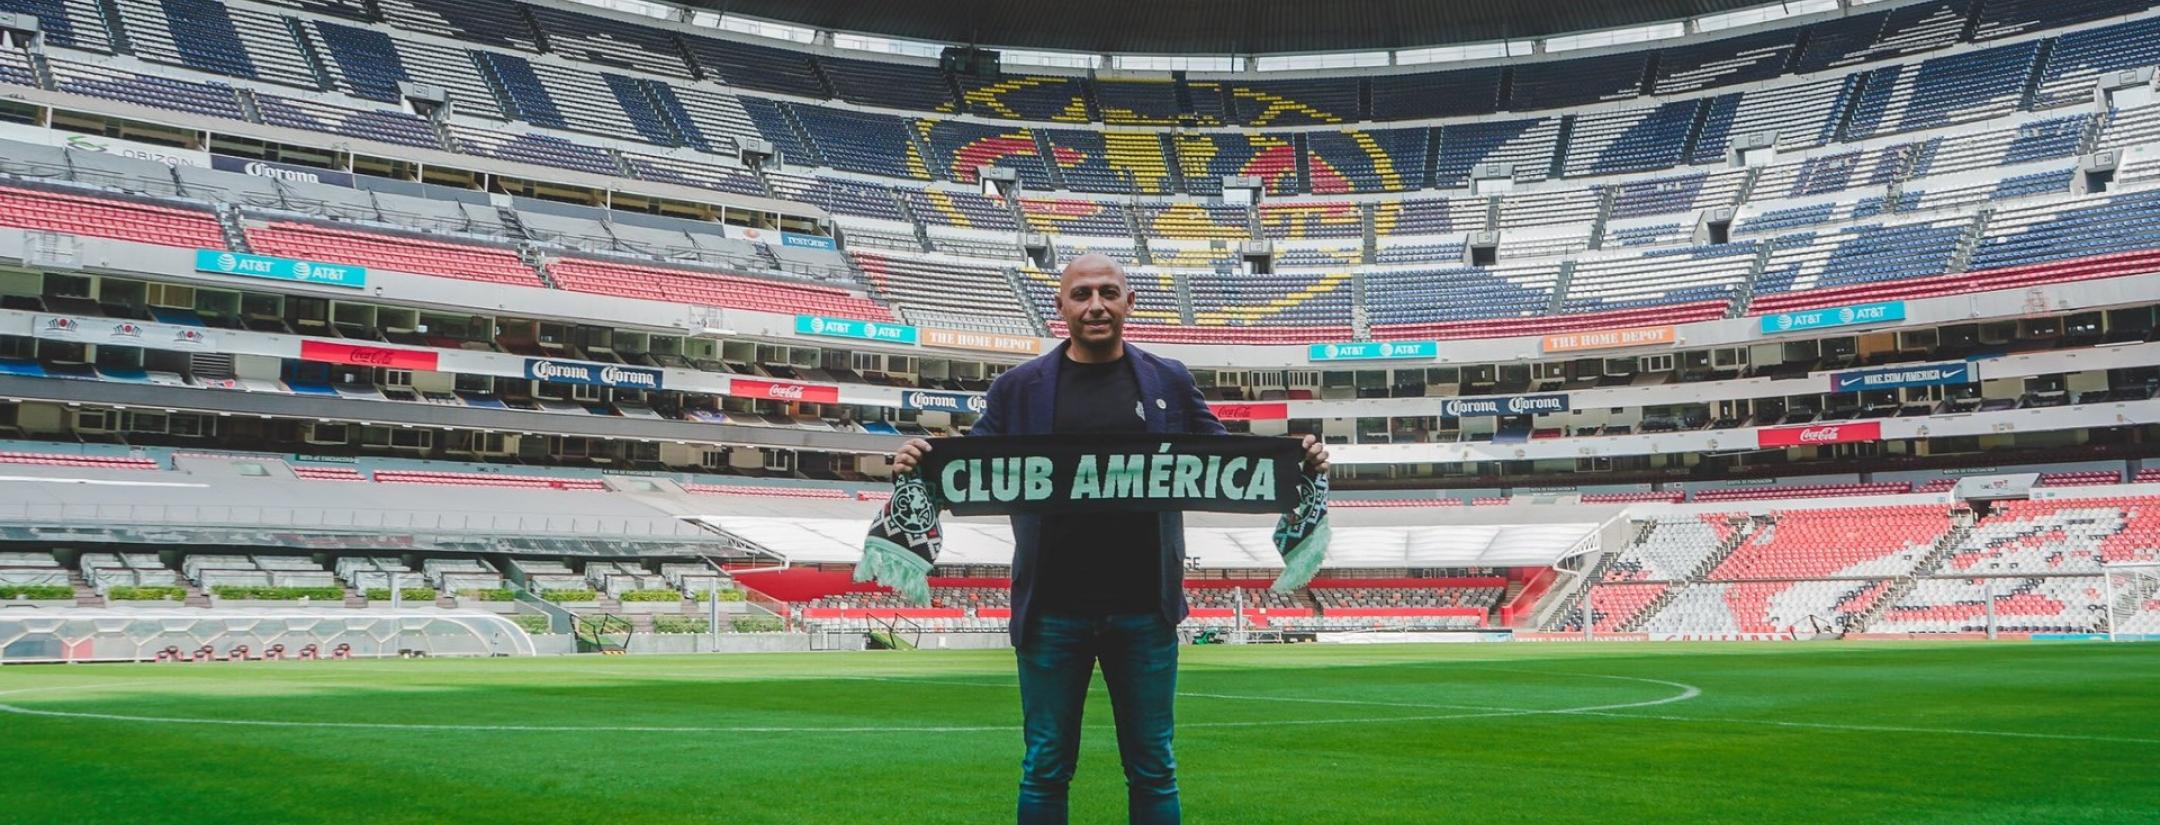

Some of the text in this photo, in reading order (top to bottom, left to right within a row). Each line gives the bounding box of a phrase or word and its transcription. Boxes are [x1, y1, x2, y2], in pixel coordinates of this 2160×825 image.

[244, 162, 319, 184] Corona
[238, 259, 347, 280] AT&T AT&T
[1793, 306, 1887, 326] AT&T AT&T
[825, 321, 902, 338] AT&T AT&T
[1550, 329, 1665, 349] THE HOME DEPOT
[929, 331, 1033, 350] THE HOME DEPOT
[1340, 344, 1421, 356] AT&T AT&T
[532, 360, 656, 386] Corona Corona
[909, 391, 959, 409] Corona
[1446, 396, 1562, 416] Corona Corona
[941, 442, 1276, 502] CLUB AMÉRICA
